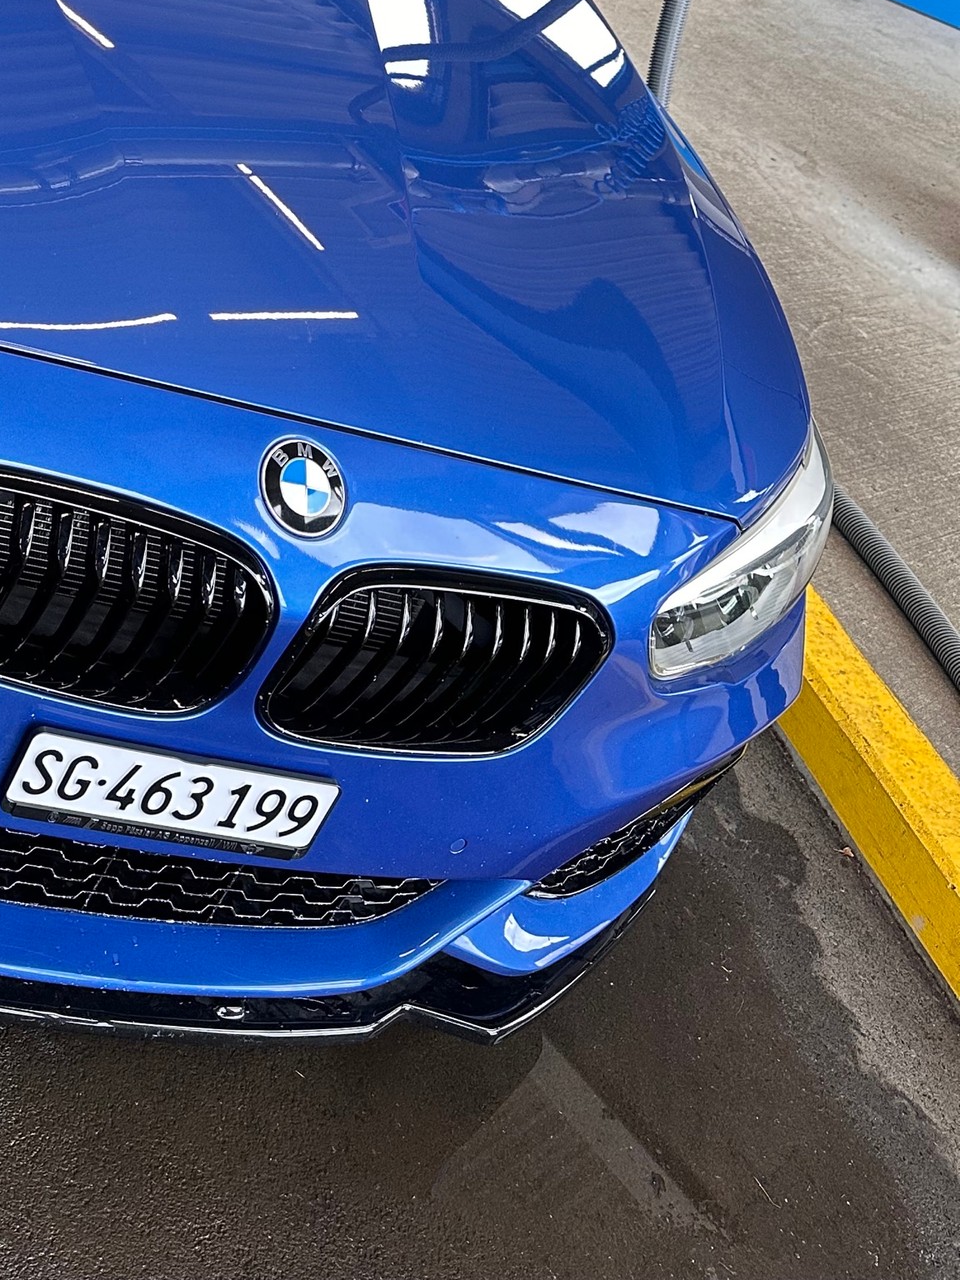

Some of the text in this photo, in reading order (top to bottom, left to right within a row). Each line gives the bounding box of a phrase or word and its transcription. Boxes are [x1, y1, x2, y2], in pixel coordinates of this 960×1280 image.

[271, 442, 337, 478] BMW
[101, 821, 124, 834] Sepp
[172, 833, 215, 849] Appenzell
